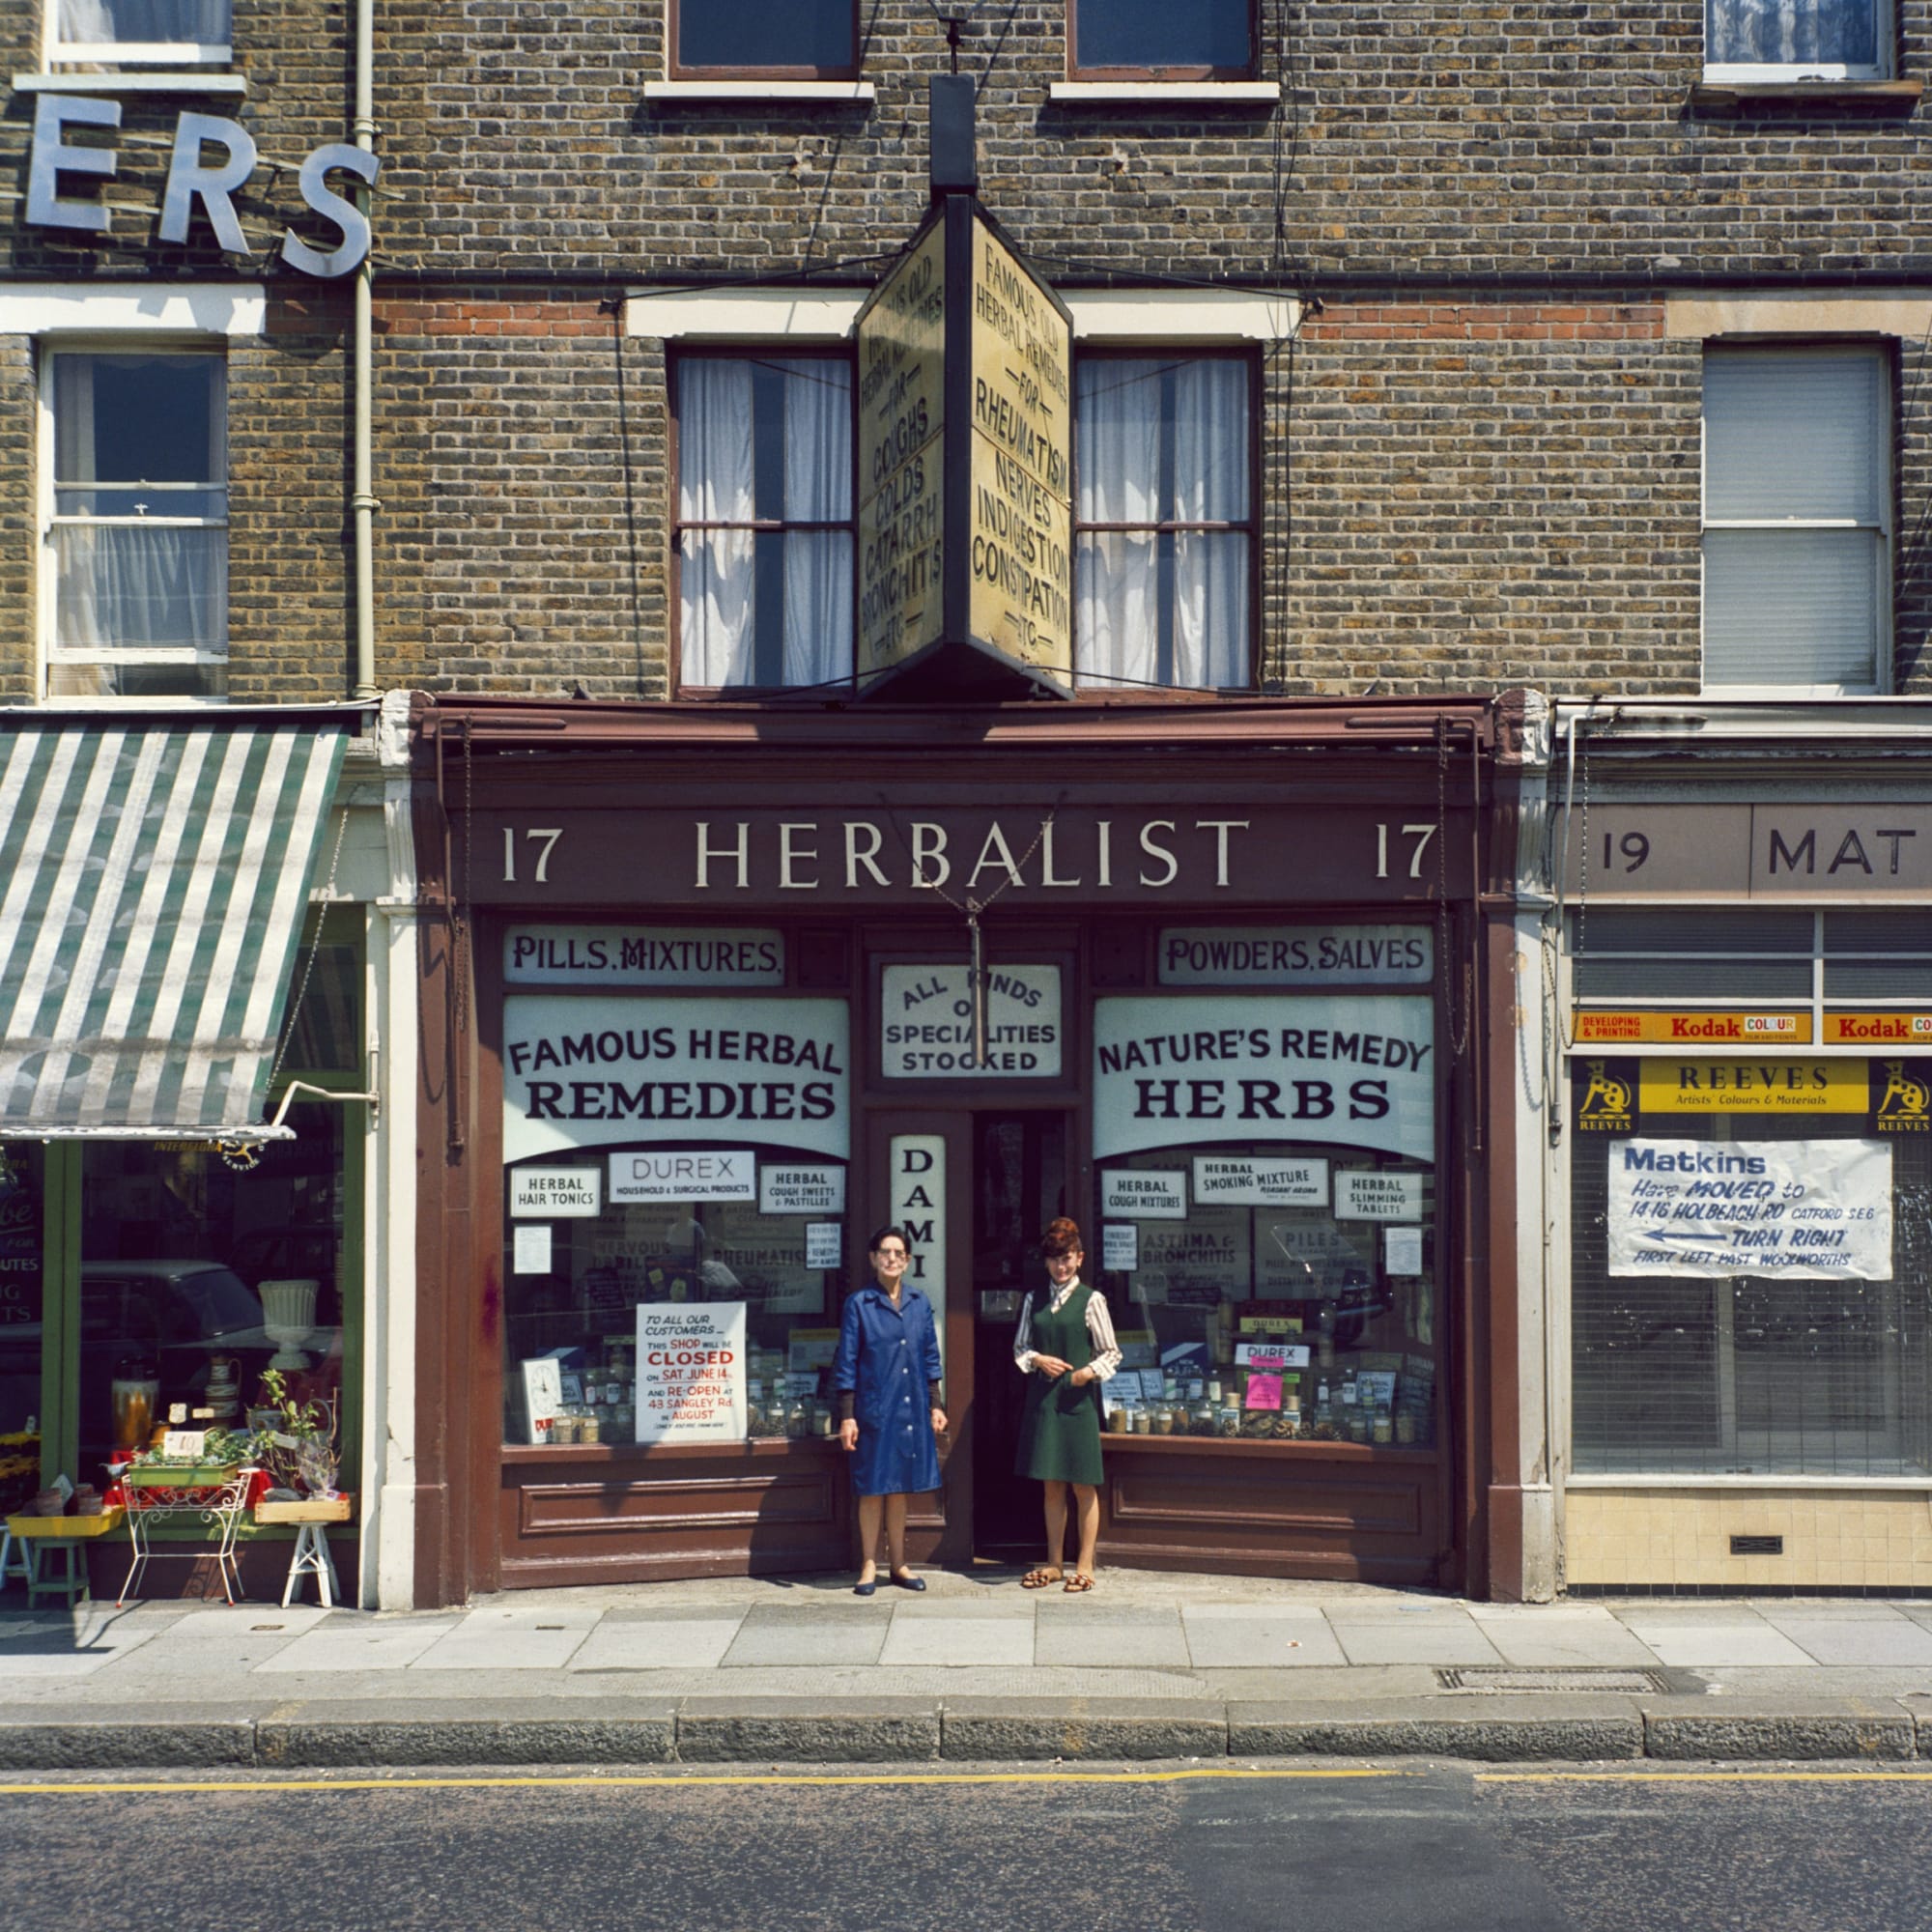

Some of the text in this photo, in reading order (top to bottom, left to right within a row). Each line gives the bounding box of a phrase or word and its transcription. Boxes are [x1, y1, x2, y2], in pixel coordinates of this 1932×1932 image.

[26, 94, 381, 277] ERS
[985, 242, 1059, 354] FAMOUS OLD
[976, 282, 1067, 405] HERBAL REMEDIES
[1018, 371, 1038, 412] FOR
[873, 397, 928, 483] COUGHS
[976, 377, 1067, 497] RHEUMATISM
[875, 456, 924, 528] COLDS
[995, 449, 1052, 529] NERVES
[866, 492, 937, 582] CATARRH
[978, 484, 1067, 588] INDIGESTION
[973, 535, 1067, 634] CONSTIPATION
[502, 821, 1437, 888] 17 HERBALIST 17
[1603, 832, 1650, 873] 19
[1769, 829, 1917, 874] MAT
[1318, 936, 1425, 970] SALVES
[902, 976, 948, 1010] ALL
[1583, 1016, 1640, 1027] DEVELOPING
[1671, 1018, 1796, 1037] Kodak COLOUR
[1839, 1019, 1909, 1037] Kodak
[1583, 1027, 1640, 1037] & PRINTING
[508, 1027, 843, 1075] FAMOUS HERBAL
[1098, 1028, 1432, 1074] NATURE'S REMEDY
[902, 1052, 1037, 1071] STOCKED
[1678, 1066, 1828, 1091] REEVES
[525, 1081, 836, 1121] REMEDIES
[1133, 1079, 1390, 1121] HERBS
[1719, 1094, 1760, 1105] Colours
[1776, 1094, 1827, 1105] Materials
[1579, 1121, 1631, 1130] REEVES
[1878, 1122, 1930, 1131] REEVES
[632, 1158, 734, 1179] DUREX
[1205, 1164, 1254, 1174] HERBAL
[1624, 1148, 1766, 1175] Matkins
[528, 1178, 584, 1190] HERBAL
[776, 1173, 827, 1184] HERBAL
[1118, 1180, 1169, 1192] HERBAL
[1204, 1170, 1310, 1191] SMOKING MIXTURE
[1351, 1179, 1403, 1191] HERBAL
[616, 1186, 664, 1195] HOUSEHOLD
[673, 1185, 710, 1195] SURGICAL
[711, 1184, 750, 1194] PRODUCTS
[769, 1187, 835, 1197] COUGH SWEETS
[1631, 1179, 1804, 1199] Have MOVED to
[519, 1193, 593, 1205] HAIR TONICS
[784, 1197, 830, 1207] PASTILLES
[1109, 1196, 1180, 1208] COUGH MIXTURES
[1350, 1193, 1406, 1205] SLIMMING
[1356, 1205, 1401, 1214] TABLETS
[1672, 1203, 1755, 1221] HOLBEACH
[1760, 1204, 1785, 1220] RD
[1791, 1208, 1843, 1220] CATFORD
[1731, 1229, 1847, 1247] TURN RIGHT
[1143, 1249, 1236, 1264] BRONCHITIS
[1633, 1250, 1676, 1264] FIRST
[1679, 1251, 1714, 1264] LEFT
[1759, 1252, 1853, 1266] WOOLWORTHS
[646, 1315, 710, 1324] TO ALL OUR
[645, 1325, 715, 1336] CUSTOMERS
[670, 1339, 700, 1350] SHOP
[1247, 1347, 1295, 1358] DUREX
[648, 1351, 734, 1366] CLOSED
[663, 1369, 683, 1380] SAT
[687, 1369, 714, 1379] JUNE
[668, 1386, 721, 1397] RE-OPEN
[648, 1399, 664, 1409] 43
[667, 1399, 714, 1409] SANGLEY
[671, 1410, 715, 1420] AUGUST
